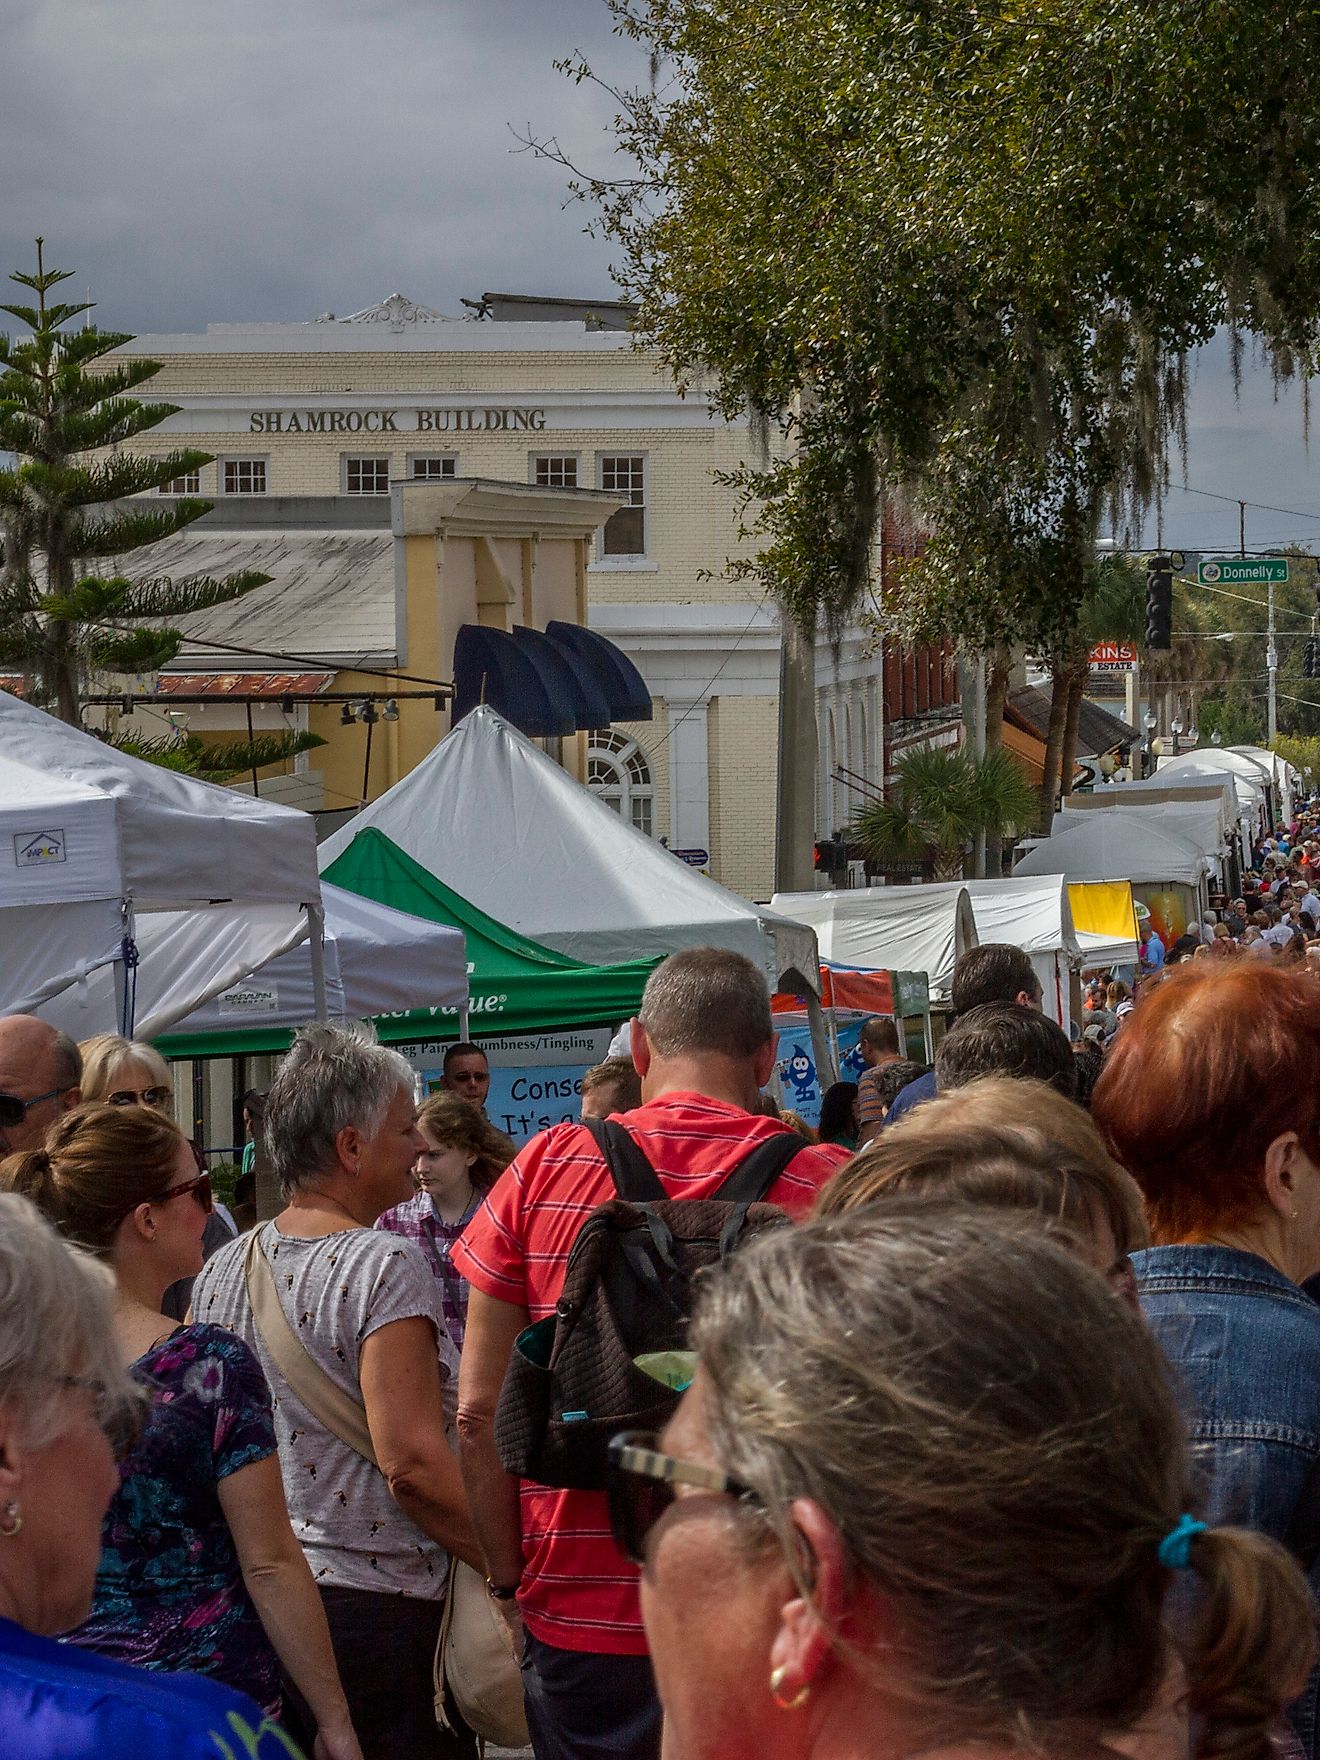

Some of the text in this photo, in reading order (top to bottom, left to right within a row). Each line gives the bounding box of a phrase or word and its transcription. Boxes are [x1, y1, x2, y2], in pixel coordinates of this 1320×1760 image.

[250, 409, 546, 433] SHAMROCK BUILDING
[1223, 566, 1274, 581] Donnelly
[1089, 646, 1132, 659] KINS
[1098, 661, 1133, 671] ESTATE
[511, 1077, 583, 1101] Conse
